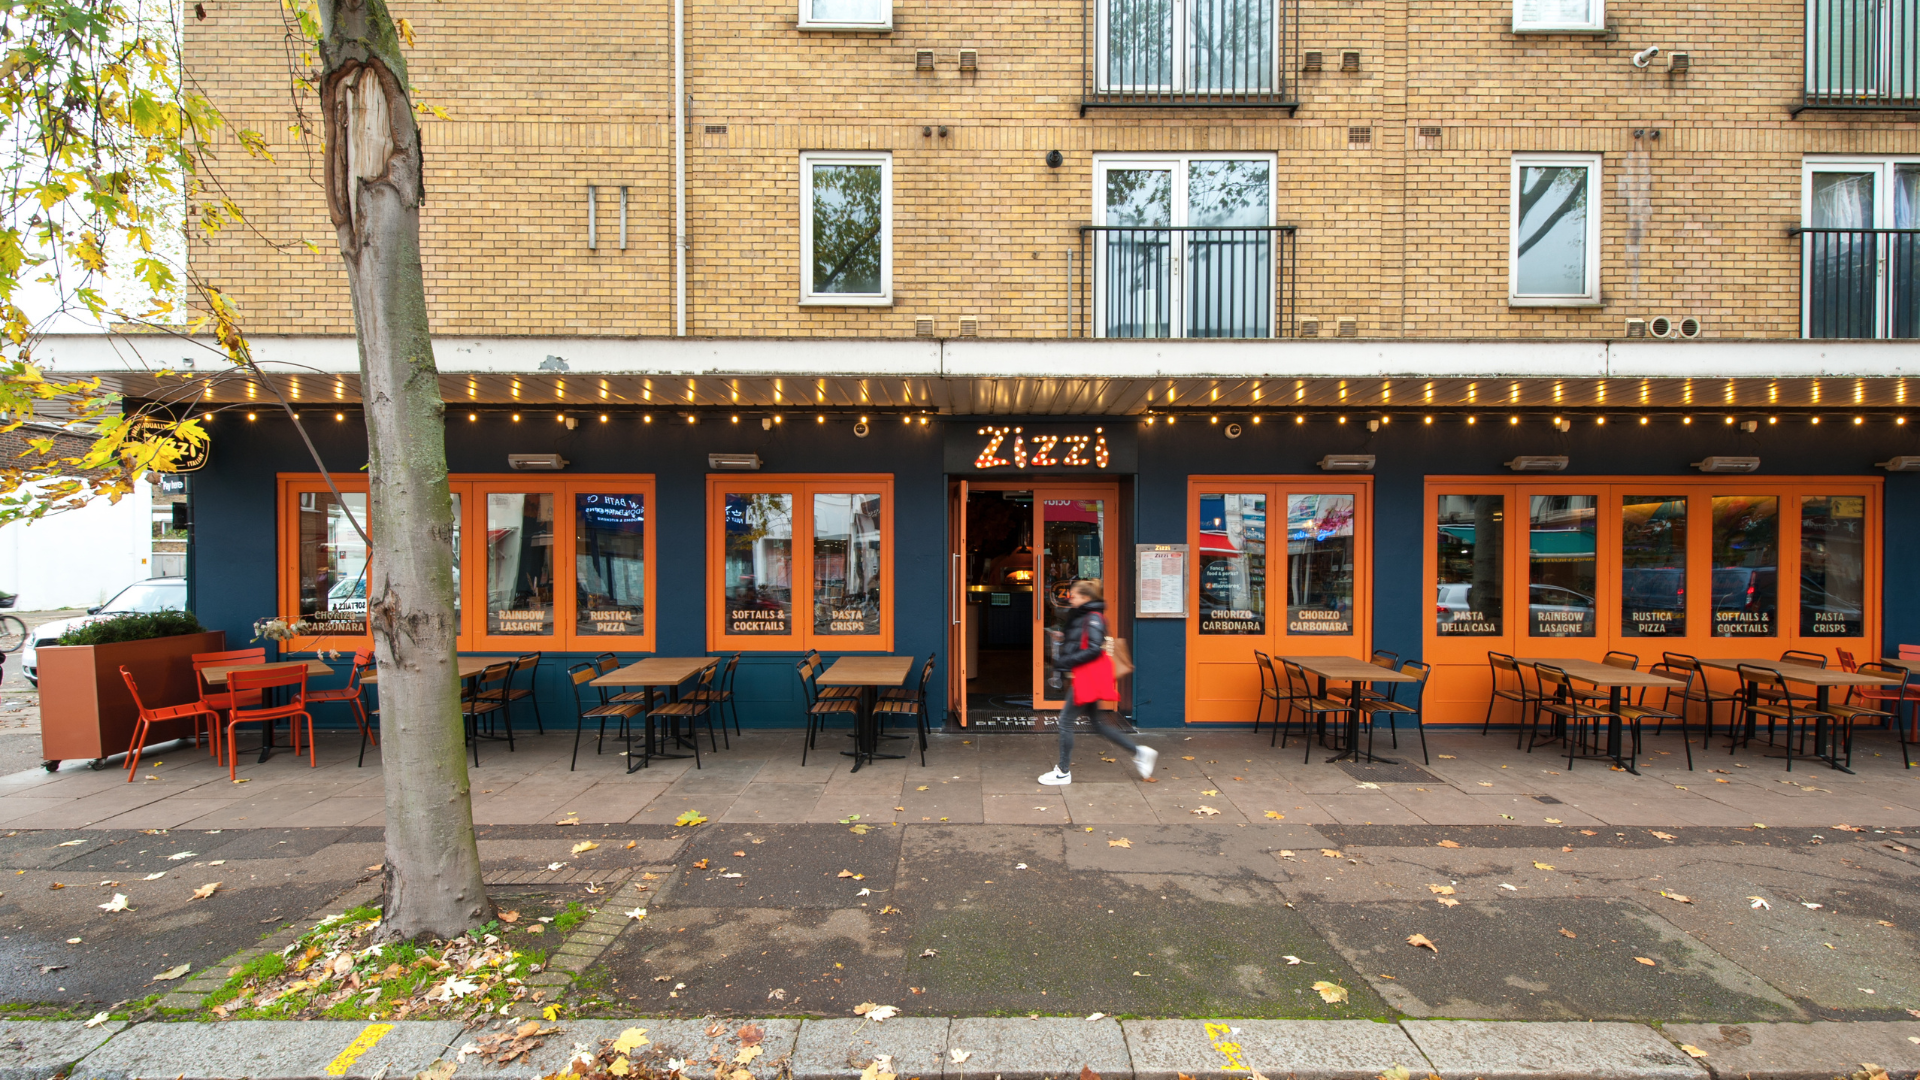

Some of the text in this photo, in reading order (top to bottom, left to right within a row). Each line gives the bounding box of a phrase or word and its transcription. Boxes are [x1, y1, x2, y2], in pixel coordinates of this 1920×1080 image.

[974, 425, 1110, 469] Zizzi
[186, 452, 205, 468] ITALIAN
[162, 480, 184, 491] Pay here
[314, 610, 356, 620] CHORIZO
[499, 610, 545, 621] RAINBOW
[590, 610, 632, 621] RUSTICA
[732, 610, 785, 620] SOFTAILS &
[832, 610, 862, 620] PASTA
[1210, 609, 1252, 620] CHORIZO
[1298, 610, 1340, 620] CHORIZO
[1453, 611, 1484, 621] PASTA
[1538, 611, 1584, 621] RAINBOW
[1632, 612, 1672, 621] RUSTICA
[1716, 612, 1769, 622] SOFTAILS &
[1815, 612, 1845, 621] PASTA
[500, 621, 543, 632] LASAGNE
[597, 622, 626, 632] PIZZA
[733, 621, 785, 631] COCKTAILS
[830, 621, 864, 631] CRISPS
[1202, 621, 1261, 631] CARBONARA
[1290, 621, 1348, 632] CARBONARA
[1441, 622, 1496, 632] DELLA CASA
[1539, 623, 1582, 633] LASAGNE
[1638, 623, 1666, 633] PIZZA
[1717, 623, 1769, 633] COCKTAILS
[1813, 623, 1846, 633] CRISPS
